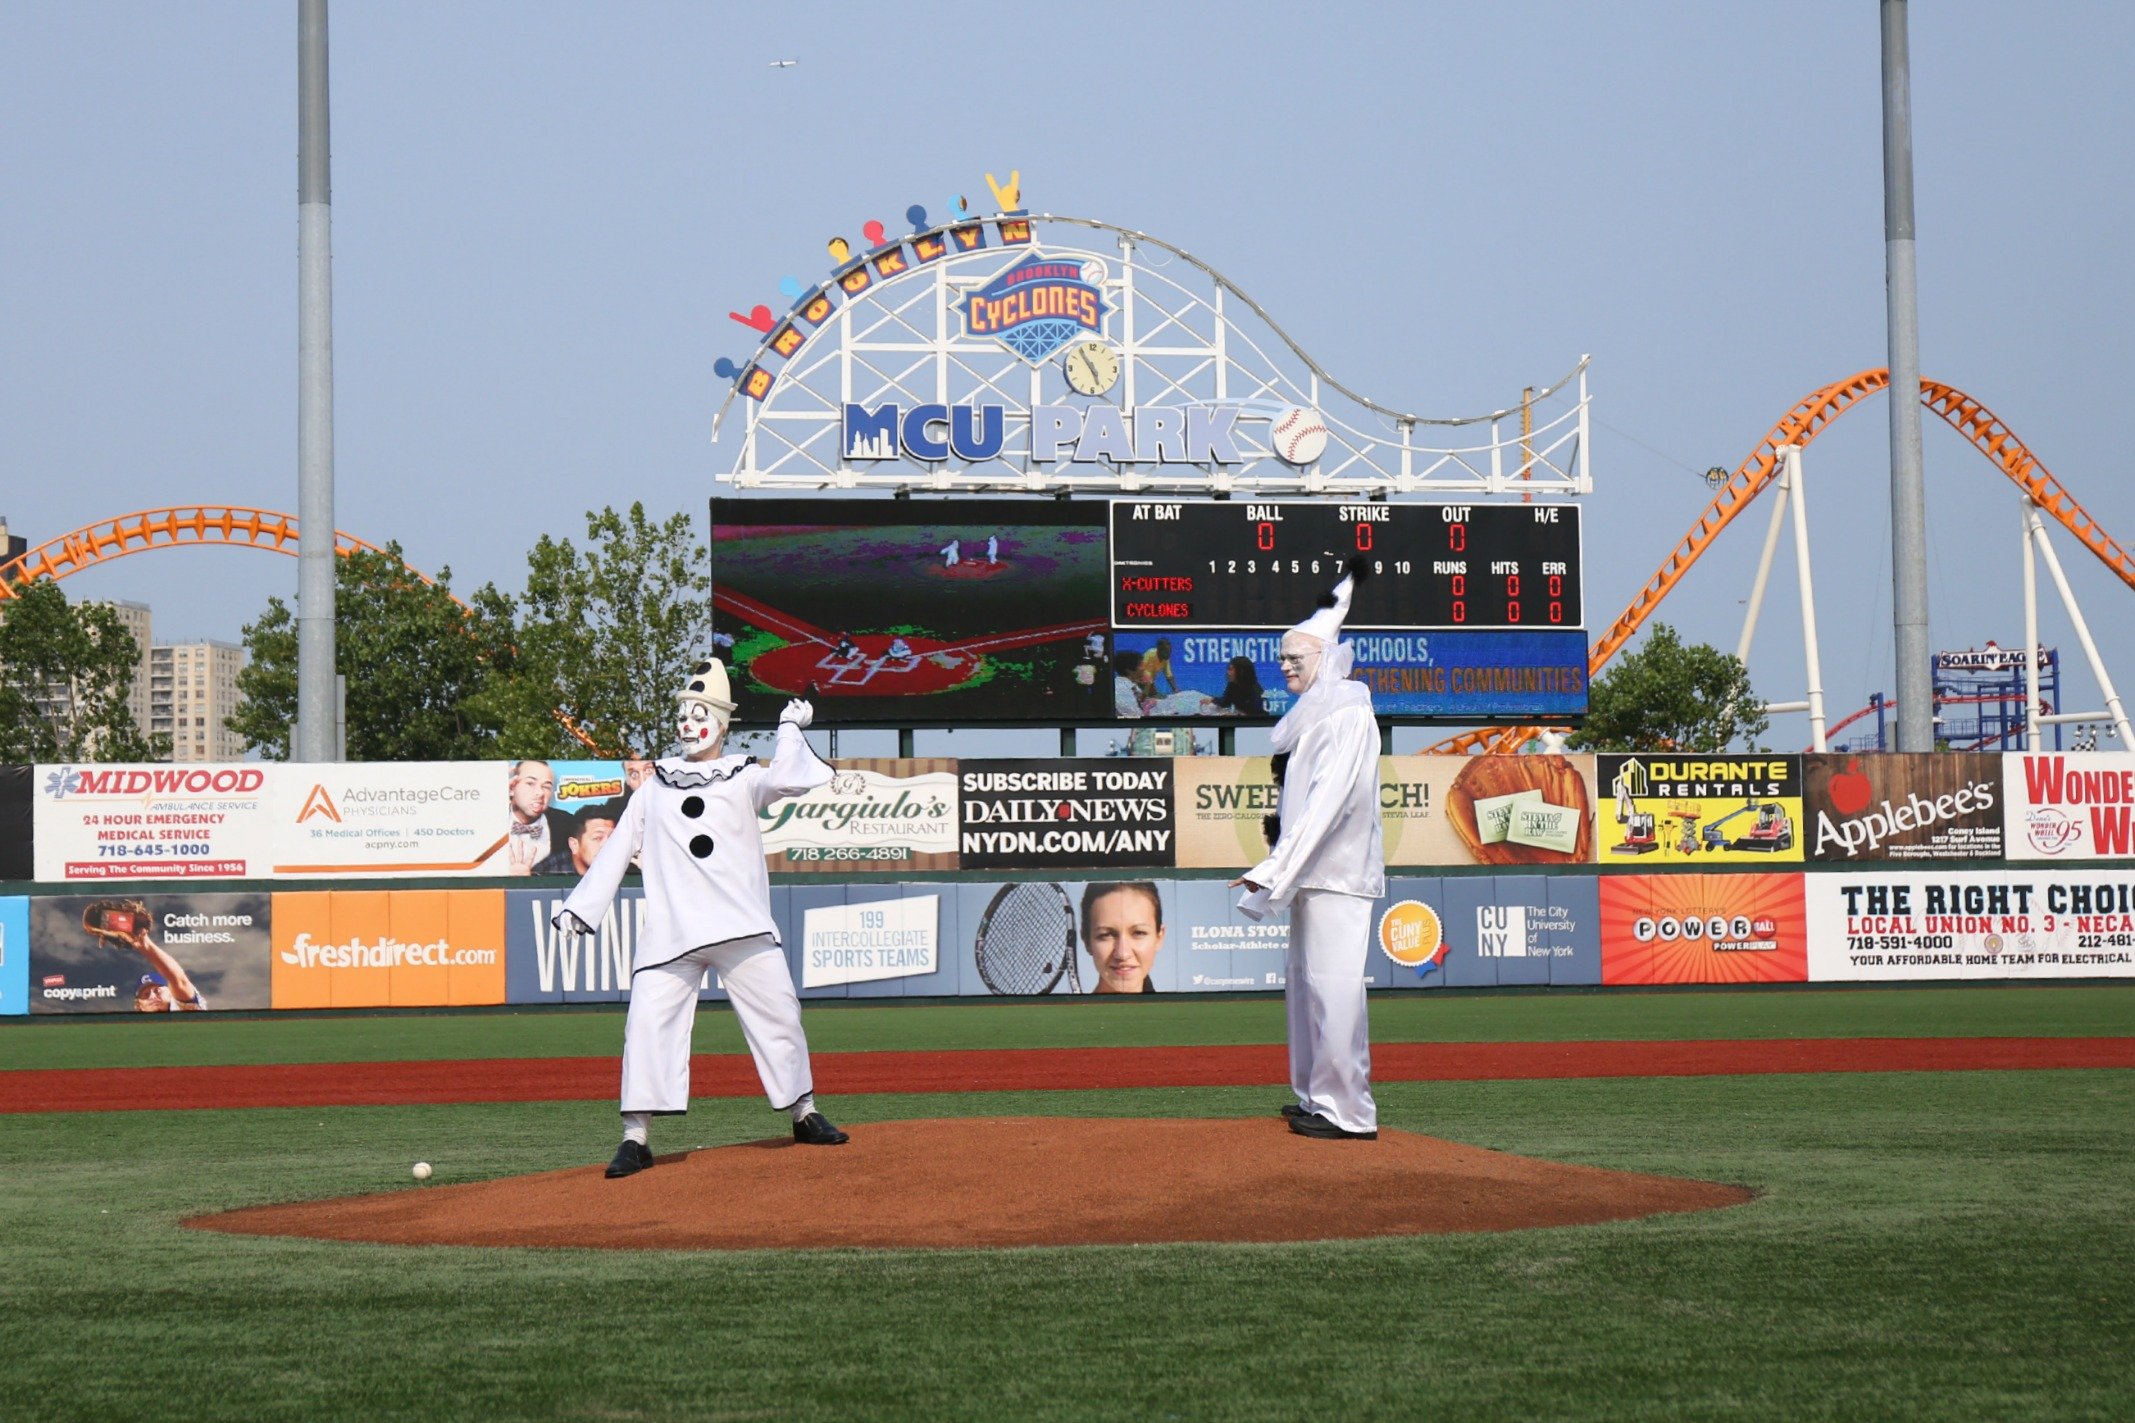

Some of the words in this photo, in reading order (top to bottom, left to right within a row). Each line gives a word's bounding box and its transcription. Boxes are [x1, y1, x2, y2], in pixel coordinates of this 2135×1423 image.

[1007, 265, 1079, 286] BROOKLYN
[746, 221, 1029, 398] BROOKLYN
[970, 286, 1098, 331] CYCLONES
[1088, 343, 1097, 351] 12
[1112, 365, 1118, 373] 3
[1089, 387, 1095, 395] 6
[843, 402, 1006, 463] MCU
[1031, 404, 1245, 465] PARK
[1132, 505, 1151, 520] AT
[1155, 505, 1182, 520] BAT
[1247, 506, 1283, 520] BALL
[1339, 506, 1390, 521] STRIKE
[1442, 507, 1471, 522] OUT
[1534, 508, 1559, 524] H/E
[1258, 522, 1274, 550] 0
[1356, 523, 1373, 551] 0
[1450, 524, 1466, 551] 0
[1209, 561, 1216, 573] 1
[1228, 561, 1236, 573] 2
[1248, 561, 1256, 573] 3
[1272, 561, 1280, 573] 4
[1291, 561, 1299, 573] 5
[1311, 561, 1319, 573] 6
[1335, 561, 1343, 573] 7
[1374, 561, 1382, 574] 9
[1395, 561, 1410, 574] 10
[1433, 561, 1467, 574] RUNS
[1491, 561, 1519, 575] HITS
[1542, 562, 1567, 575] ERR
[1452, 576, 1464, 596] 0
[1508, 576, 1519, 596] 0
[1550, 576, 1561, 596] 0
[1127, 603, 1189, 617] CYCLONES
[1453, 601, 1465, 622] 0
[1508, 602, 1520, 622] 0
[1550, 602, 1561, 622] 0
[1346, 637, 1433, 666] CHOOLS,
[1941, 653, 1997, 666] SOARIN'
[2000, 651, 2046, 663] EAGE
[1452, 667, 1582, 693] COMMUNITIES
[1650, 762, 1787, 781] DURANTE
[74, 769, 264, 793] MIDWOOD
[963, 772, 1087, 791] SUBSCRIBE
[1092, 771, 1167, 790] TODAY
[2023, 756, 2135, 805] WONDE
[343, 786, 480, 805] AdvantageCare
[558, 780, 622, 799] JOKERS
[1196, 784, 1280, 809] SWEE
[1659, 783, 1780, 796] RENTALS
[150, 802, 213, 810] AMBULANCE
[216, 802, 257, 810] SERVICE
[343, 806, 416, 816] PHYSICIANS
[759, 790, 950, 833] Gargiulo's
[964, 799, 1063, 823] DAILY
[1067, 798, 1167, 822] NEWS
[83, 815, 99, 825] 24
[103, 815, 142, 824] HOUR
[146, 814, 225, 824] EMERGENCY
[1213, 812, 1267, 820] ZERO-CALORI
[1815, 781, 1994, 856] Applebee's
[98, 830, 155, 840] MEDICAL
[159, 830, 210, 839] SERVICE
[325, 829, 362, 837] Medical
[366, 829, 400, 837] Offices
[414, 828, 433, 836] 450
[436, 828, 475, 836] Doctors
[2043, 820, 2084, 848] 95
[98, 844, 209, 856] 718-645-1000
[364, 840, 419, 850] acpny.com
[963, 830, 1171, 854] NYDN.COM/ANY
[791, 848, 820, 860] 718
[824, 848, 907, 860] 266-4891
[68, 865, 106, 875] Serving
[108, 865, 127, 873] The
[130, 865, 186, 875] Community
[188, 864, 214, 872] Since
[217, 864, 243, 872] 1956
[1841, 885, 1911, 915] THE
[1925, 885, 2033, 915] RIGHT
[2048, 884, 2135, 914] CHOI
[164, 913, 209, 927] Catch
[212, 915, 252, 926] more
[860, 911, 884, 928] 199
[1527, 906, 1546, 917] The
[1548, 906, 1568, 919] City
[1192, 926, 1245, 938] ILONA
[1391, 920, 1422, 941] CUNY
[1527, 919, 1575, 932] University
[1847, 916, 1917, 934] LOCAL
[1925, 916, 1992, 933] UNION
[2001, 915, 2035, 933] NO.
[2044, 915, 2055, 932] 3
[2077, 915, 2134, 932] NECA
[164, 931, 235, 943] business.
[812, 930, 928, 947] INTERCOLLEGIATE
[1393, 935, 1420, 952] VALUE
[1528, 932, 1538, 943] of
[1847, 936, 1952, 949] 718-591-4000
[292, 933, 495, 968] freshdirect.com
[1192, 942, 1279, 950] Scholar-Athlete
[1528, 946, 1550, 957] New
[1552, 945, 1574, 957] York
[812, 949, 873, 968] SPORTS
[878, 948, 929, 966] TEAMS
[1850, 955, 1883, 965] YOUR
[1887, 955, 1962, 965] AFFORDABLE
[1966, 955, 1997, 965] HOME
[2001, 954, 2034, 964] TEAM
[2037, 953, 2059, 963] FOR
[2062, 953, 2132, 964] ELECTRICAL
